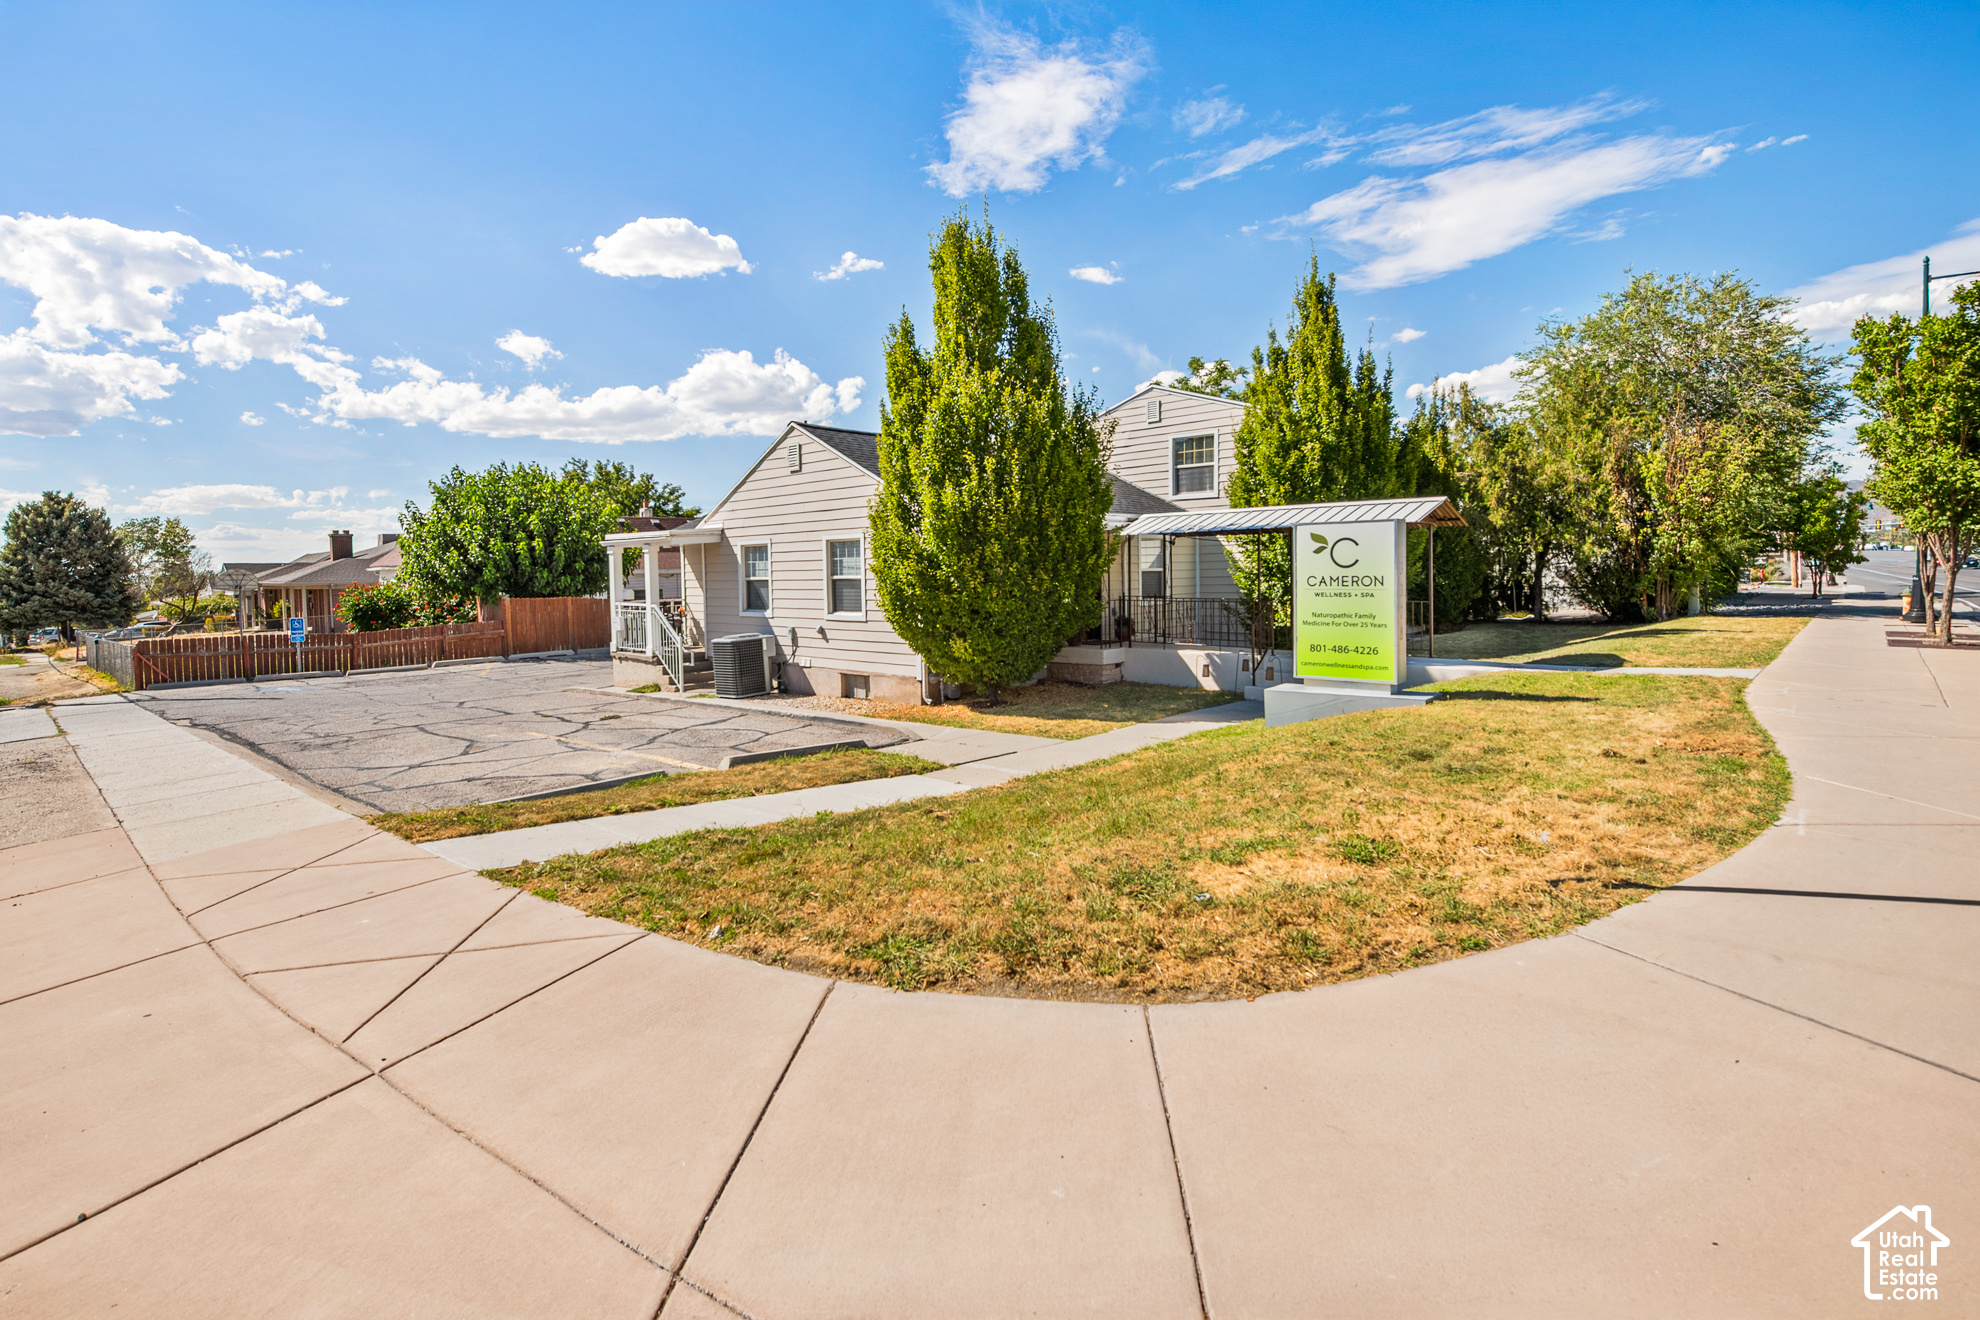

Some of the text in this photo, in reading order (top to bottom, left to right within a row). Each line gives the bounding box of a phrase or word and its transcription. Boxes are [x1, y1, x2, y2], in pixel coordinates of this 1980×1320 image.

[1330, 537, 1359, 568] C
[1306, 575, 1384, 587] CAMERON
[1354, 612, 1376, 620] Family
[1309, 644, 1379, 655] 801-486-4226
[1301, 661, 1389, 671] cameronwellnessandspa.com
